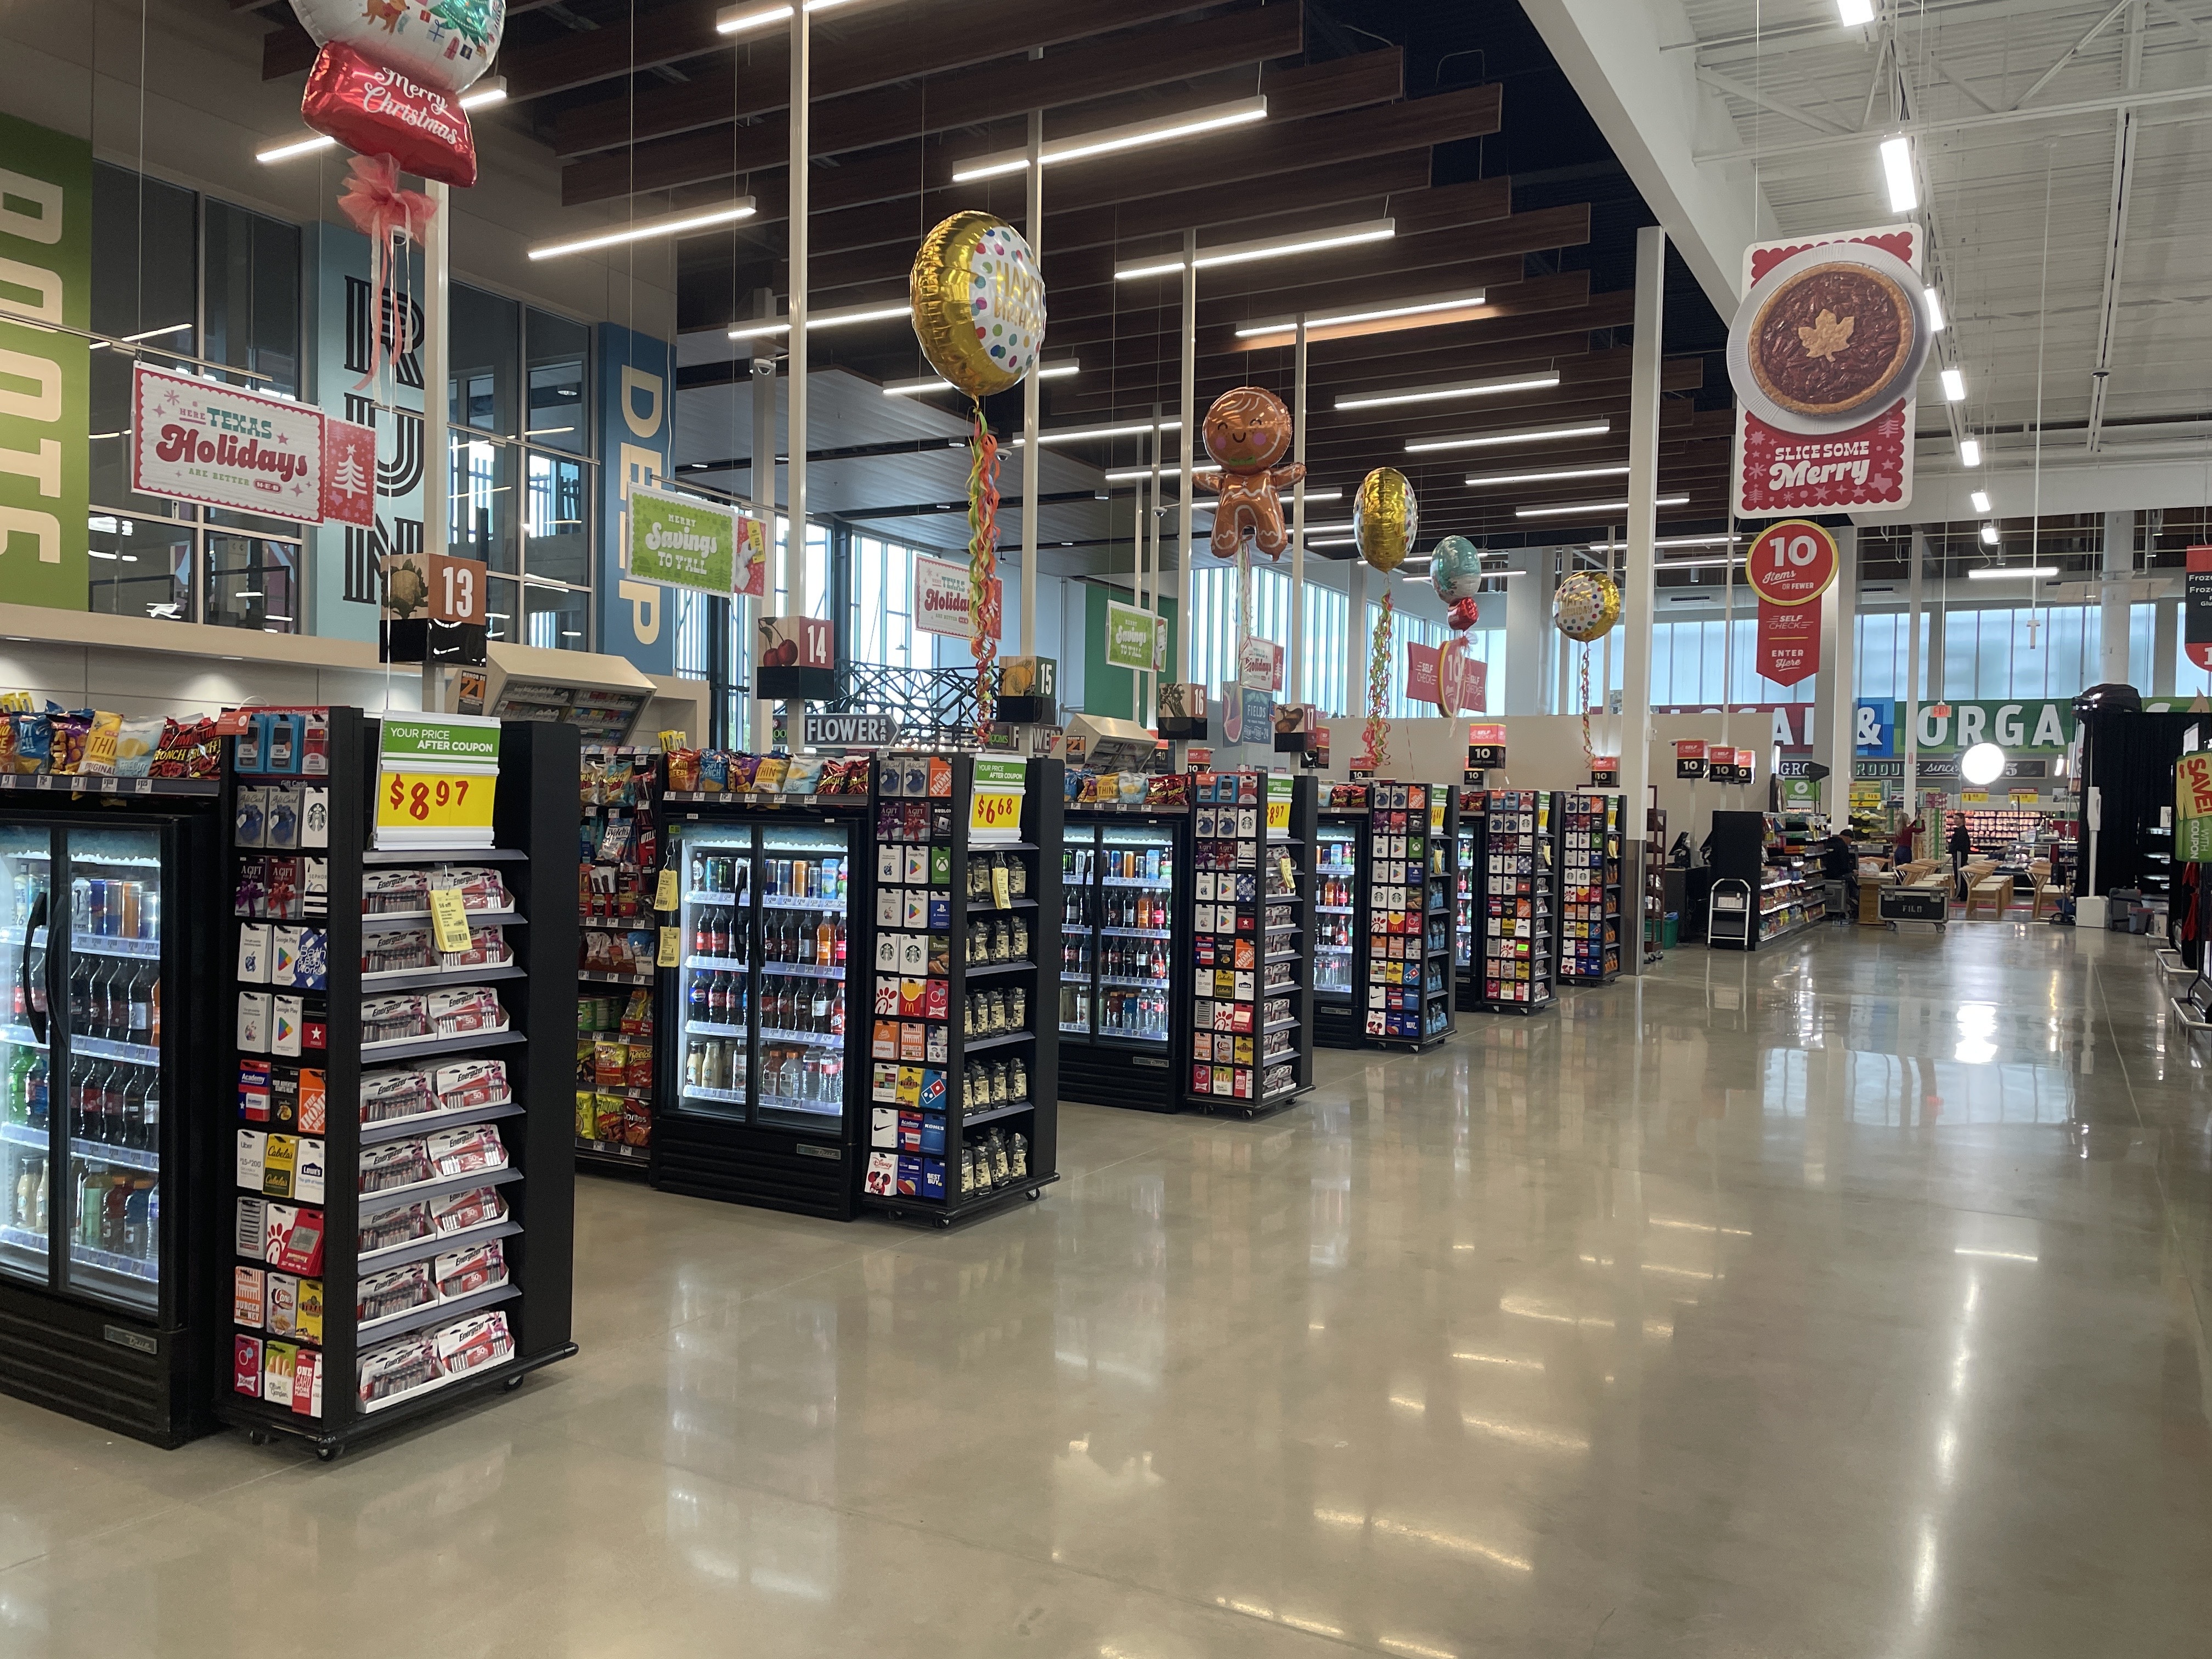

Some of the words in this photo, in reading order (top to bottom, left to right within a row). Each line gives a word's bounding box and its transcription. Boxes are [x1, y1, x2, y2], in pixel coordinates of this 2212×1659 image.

[374, 67, 448, 115] Merry
[363, 82, 458, 145] Christmas
[179, 407, 206, 421] HERE
[206, 407, 273, 439] TEXAS
[156, 424, 308, 482] Holidays
[1775, 444, 1821, 462] SLICE
[1822, 441, 1870, 459] SOME
[188, 467, 208, 478] ARE
[212, 472, 250, 487] BETTER
[1768, 458, 1871, 491] Merry
[619, 364, 663, 645] DEP
[668, 514, 697, 527] MERRY
[645, 522, 718, 558] Savings
[1769, 535, 1818, 567] 10
[657, 551, 673, 568] TO
[675, 554, 708, 575] Y'ALL
[941, 576, 966, 592] TEXAS
[1762, 570, 1797, 584] Items
[443, 566, 474, 618] 13
[1791, 582, 1814, 590] FEWER
[924, 588, 970, 613] Holida
[808, 624, 826, 664] 14
[1115, 625, 1147, 647] Savings
[1120, 644, 1127, 655] TO
[1422, 662, 1434, 673] SELF
[1448, 654, 1465, 683] 10
[1775, 658, 1801, 669] Here
[1040, 659, 1052, 696] 15
[460, 678, 485, 698] 21
[1194, 689, 1204, 715] 16
[1248, 705, 1266, 718] FIELDS
[1307, 708, 1314, 730] 17
[390, 727, 419, 738] YOUR
[421, 729, 450, 741] PRICE
[807, 719, 878, 742] FLOWER
[1857, 707, 1883, 745] &
[417, 740, 450, 751] AFTER
[452, 742, 493, 753] COUPON
[1068, 740, 1085, 752] 21
[1475, 748, 1491, 759] 10
[756, 766, 776, 778] THIN
[1683, 761, 1698, 770] 10
[1716, 766, 1729, 775] 10
[930, 769, 952, 795] HOME
[2187, 758, 2212, 815] SAVE!
[1098, 786, 1114, 795] THIN
[885, 808, 898, 817] GIFT
[912, 809, 923, 817] GIFT
[607, 826, 629, 837] Welch's
[2190, 820, 2200, 859] COUPON
[2201, 828, 2209, 851] WITH
[241, 865, 246, 874] A
[247, 866, 262, 879] GIFT
[273, 867, 278, 876] A
[279, 867, 293, 881] GIFT
[453, 872, 479, 886] Energizer
[377, 875, 407, 890] Energizer
[377, 933, 408, 947] Energizer
[300, 944, 326, 960] Bath
[303, 957, 325, 967] Body
[449, 992, 475, 1007] Energizer
[289, 1007, 298, 1015] Play
[372, 1001, 403, 1017] Energizer
[241, 1073, 266, 1082] Academy
[457, 1067, 483, 1082] Energizer
[377, 1078, 407, 1094] Energizer
[300, 1091, 325, 1130] HOM
[623, 1111, 647, 1124] Doritos
[449, 1131, 475, 1148] Energizer
[374, 1147, 404, 1165] Energizer
[872, 1156, 893, 1167] Disney
[455, 1247, 481, 1267] Energizer
[374, 1272, 404, 1291] Energizer
[236, 1299, 259, 1312] BURGER
[459, 1321, 484, 1342] Energizer
[295, 1375, 312, 1388] CARD
